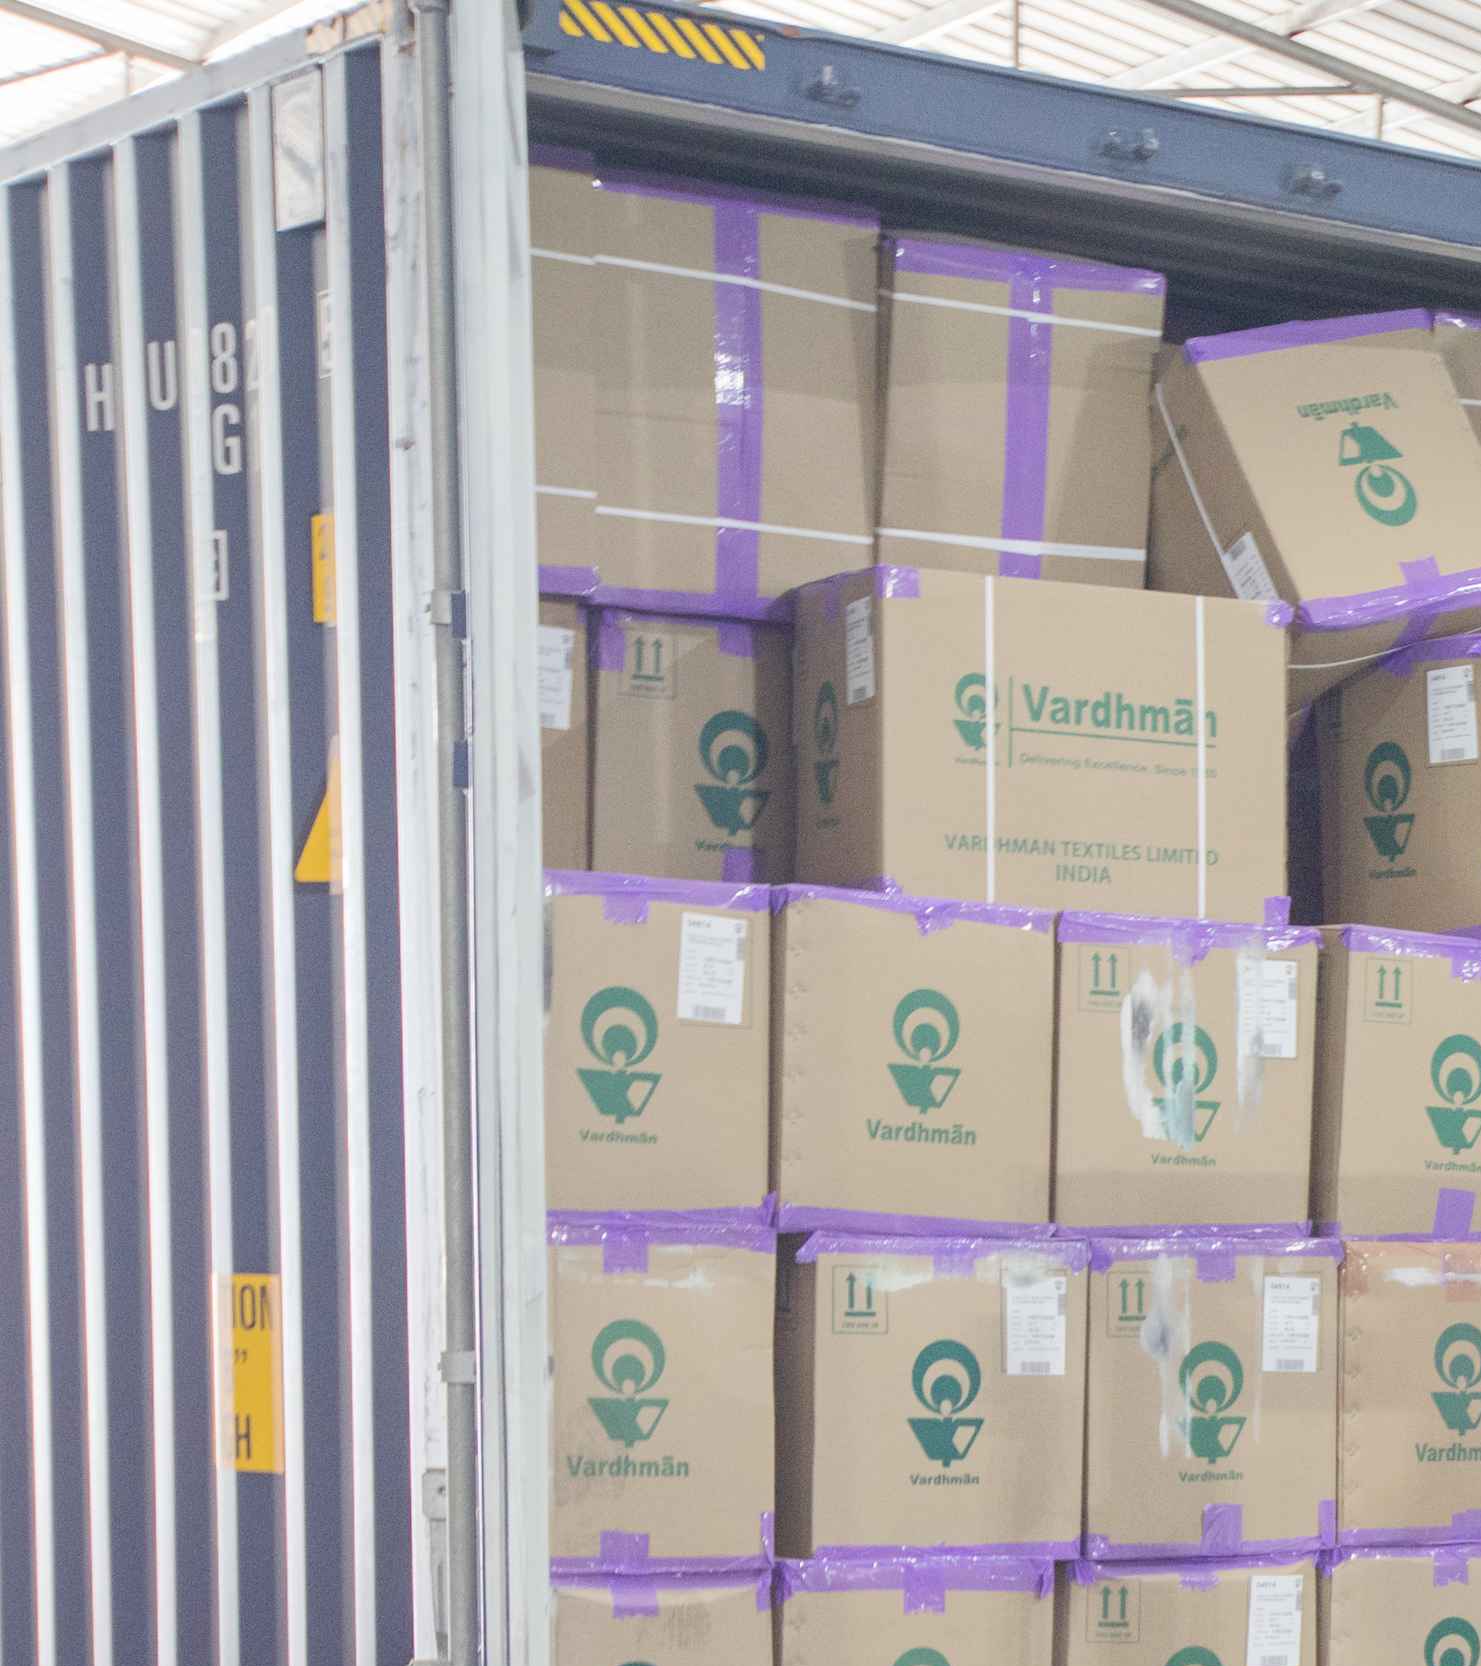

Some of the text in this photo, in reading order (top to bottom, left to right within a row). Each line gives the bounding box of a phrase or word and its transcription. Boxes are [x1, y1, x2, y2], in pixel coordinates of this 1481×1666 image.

[944, 833, 1219, 867] VARHMAN TEXTILES LIMITD
[1055, 864, 1113, 884] INDIA
[865, 1118, 977, 1146] Vardhmān
[566, 1454, 690, 1479] Vardhmān
